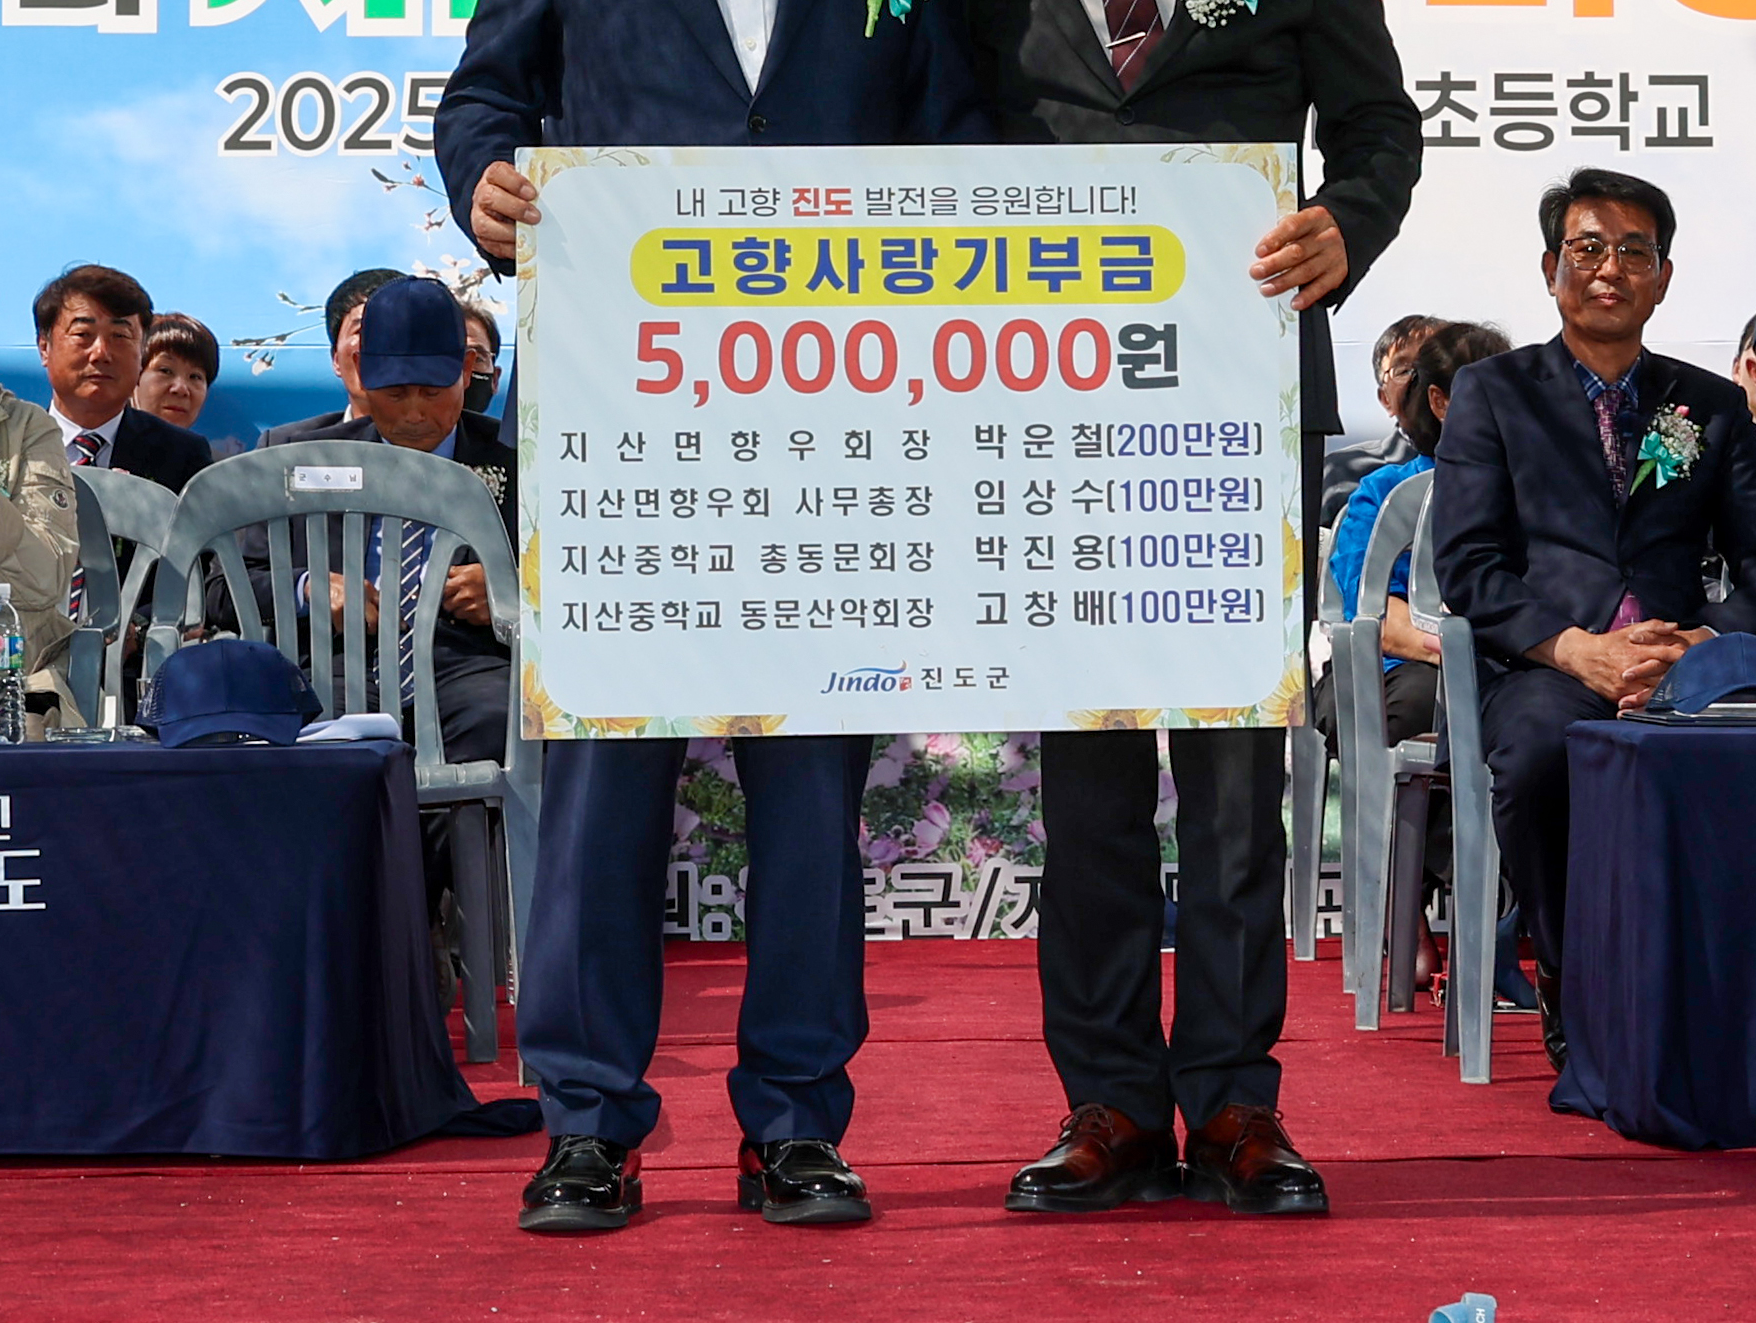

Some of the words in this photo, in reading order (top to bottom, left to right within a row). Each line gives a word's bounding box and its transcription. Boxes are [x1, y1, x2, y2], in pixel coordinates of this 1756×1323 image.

[677, 188, 705, 217] 내
[718, 188, 781, 217] 고향
[792, 187, 854, 217] 진도
[865, 187, 958, 217] 발전을
[970, 186, 1137, 216] 응원합니다!
[660, 235, 1155, 296] 고향사랑기부금
[635, 317, 1180, 409] 5,000,000원
[560, 487, 770, 519] 지산면향우회
[795, 486, 933, 517] 사무총장
[560, 544, 735, 576] 지산중학교
[760, 542, 935, 574] 총동문회장
[561, 600, 722, 632] 지산중학교
[741, 598, 935, 631] 동문산악회장
